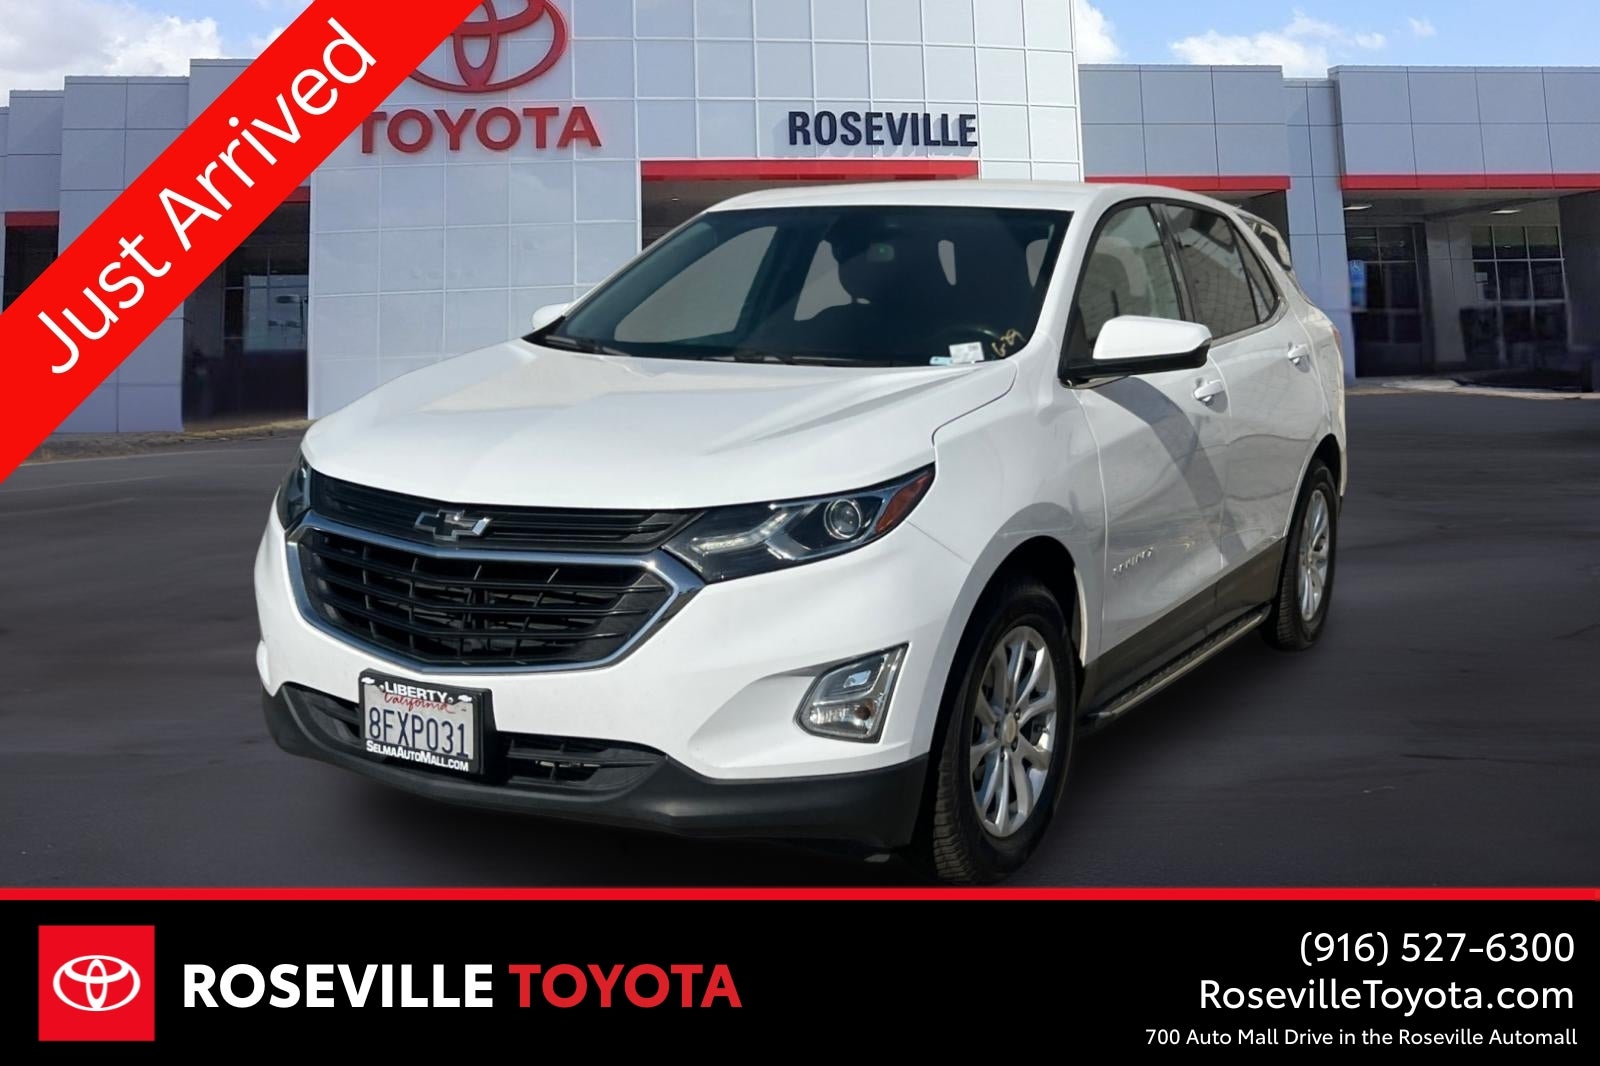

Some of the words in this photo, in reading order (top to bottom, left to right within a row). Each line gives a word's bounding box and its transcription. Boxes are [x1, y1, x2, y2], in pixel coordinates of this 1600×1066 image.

[362, 107, 602, 153] TOYOTA
[788, 111, 978, 147] ROSEVILLE
[385, 681, 448, 703] LIBERTY
[369, 707, 469, 758] 8FXP031
